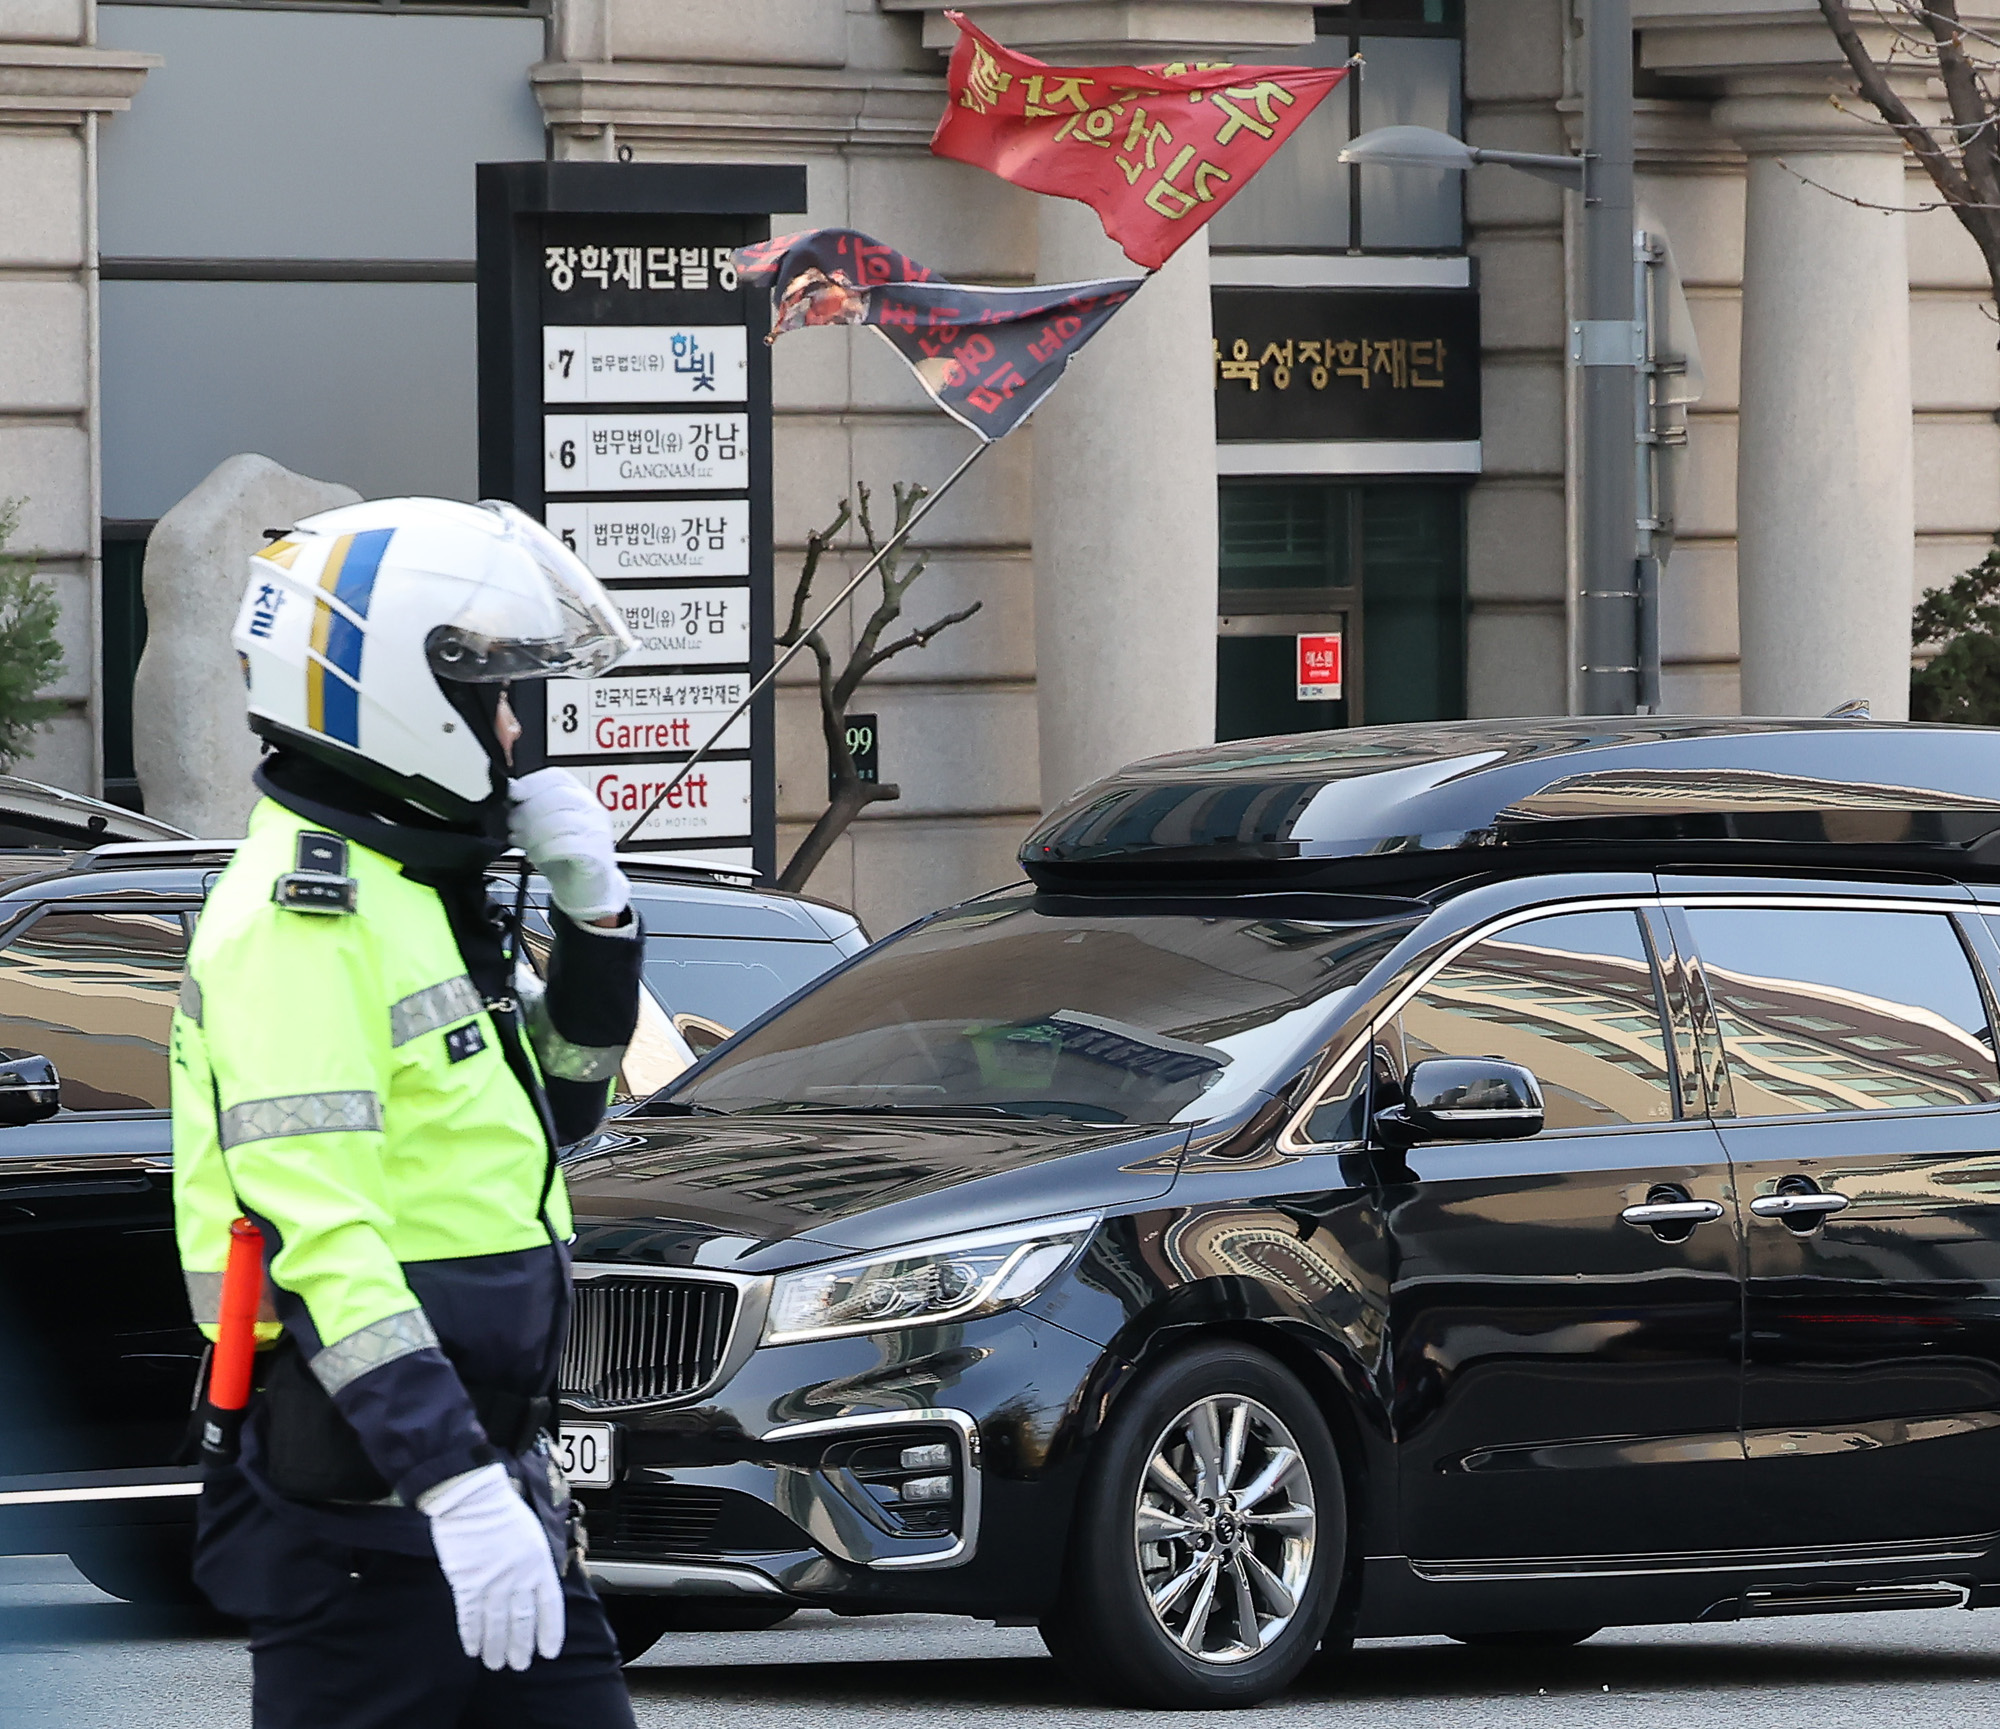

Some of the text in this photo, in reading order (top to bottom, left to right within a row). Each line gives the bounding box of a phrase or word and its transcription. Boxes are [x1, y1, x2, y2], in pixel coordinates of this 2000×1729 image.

[558, 349, 575, 379] 7
[592, 355, 665, 373] 법무법인(유)
[560, 440, 576, 469] 6
[592, 423, 740, 461] 법무법인(유) 강남
[562, 528, 577, 553] 5
[594, 517, 728, 551] 법무법인(유) 강남
[249, 583, 287, 639] 찰
[616, 601, 728, 636] 법인(유) 강남
[594, 684, 742, 709] 한국지도자육성장학재단
[562, 703, 578, 733] 3
[595, 716, 691, 749] Garrett
[846, 727, 873, 755] 99
[596, 773, 708, 812] Garrett
[665, 816, 708, 828] MOTION
[561, 1434, 596, 1474] 30
